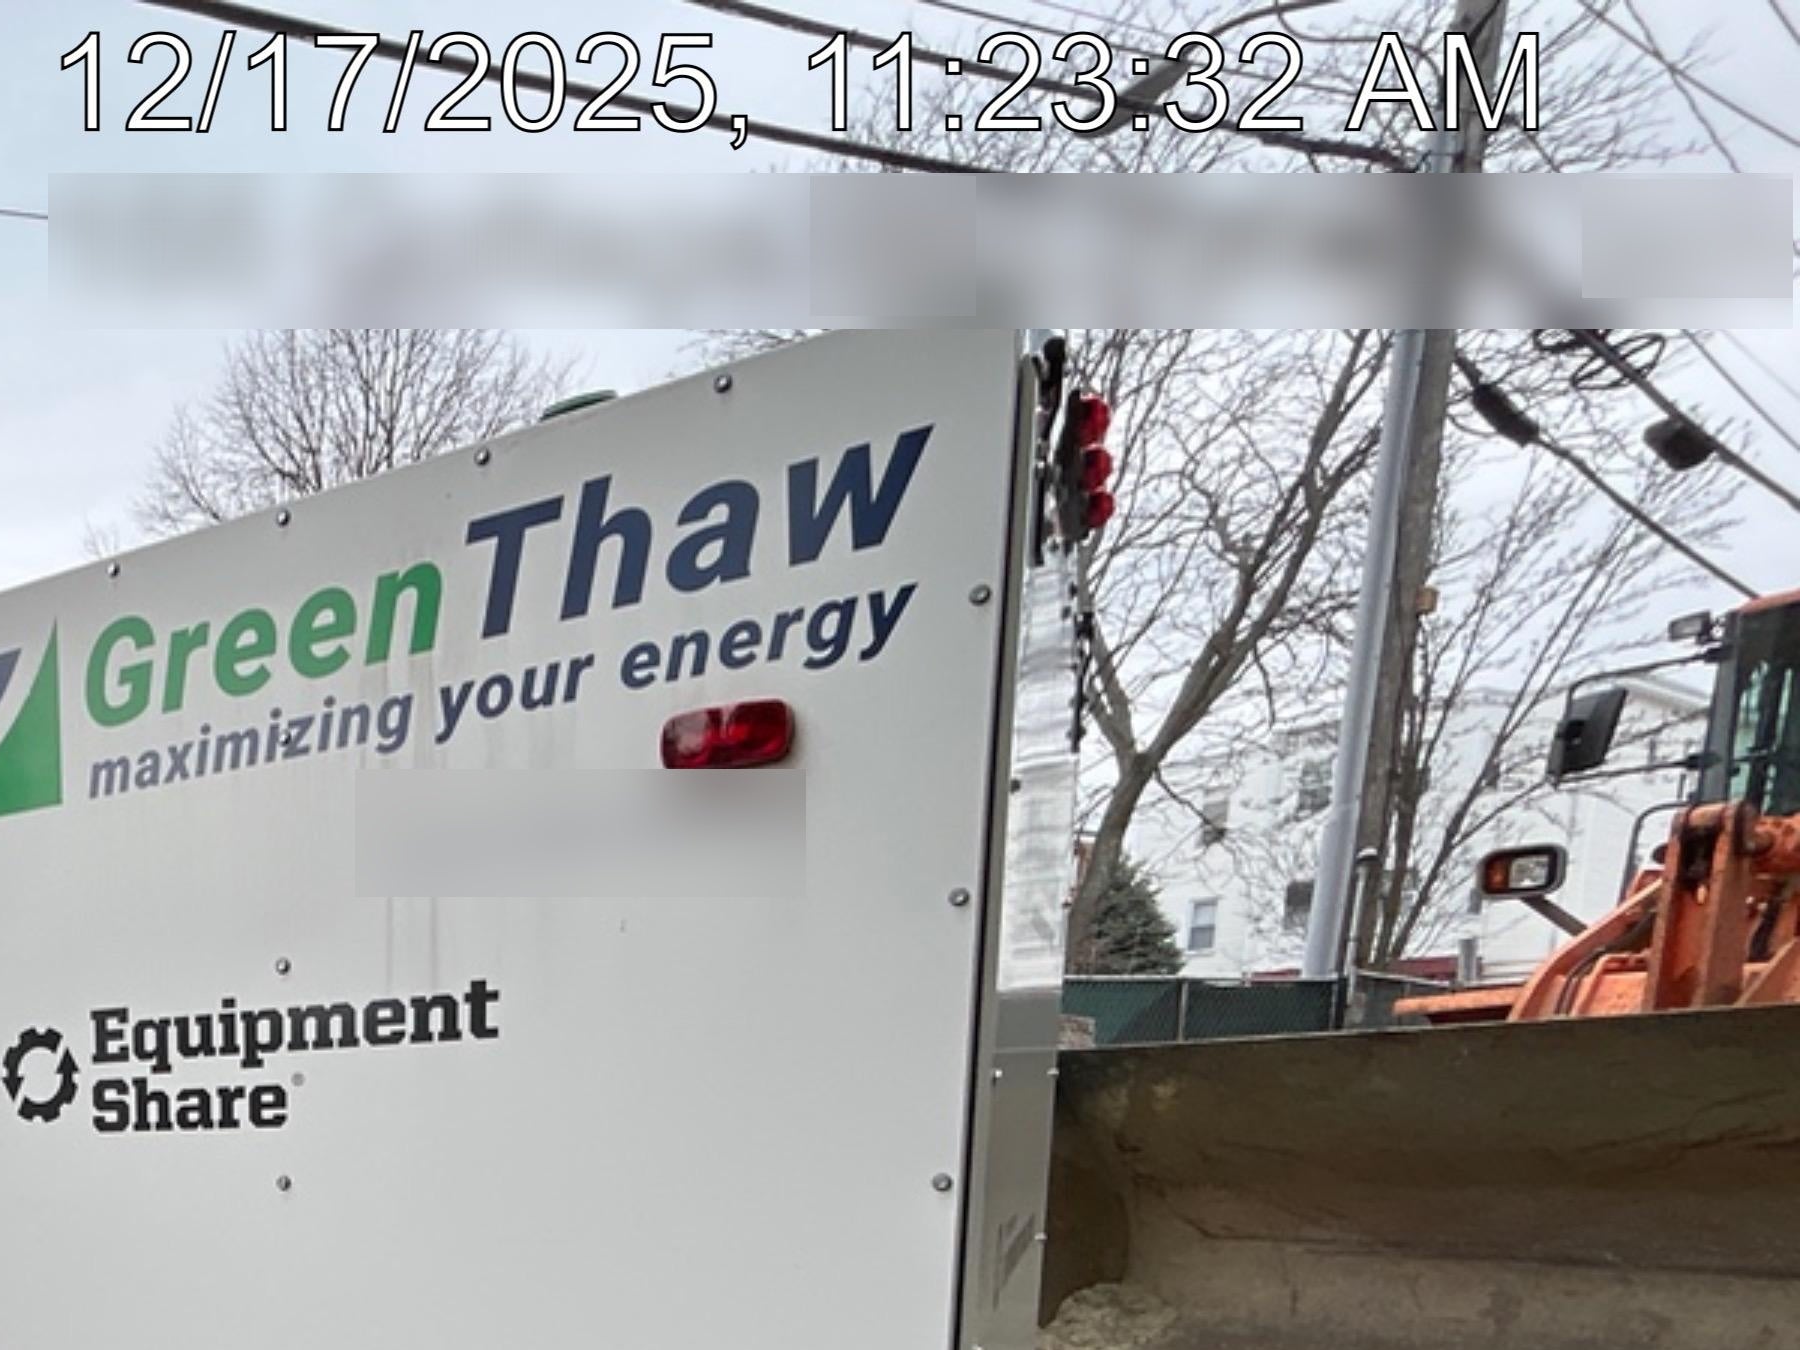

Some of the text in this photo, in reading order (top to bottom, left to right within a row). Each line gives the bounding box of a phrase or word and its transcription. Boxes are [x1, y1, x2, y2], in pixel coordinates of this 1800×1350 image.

[88, 582, 920, 799] maximizing your energy
[89, 979, 500, 1074] Equipment
[92, 1077, 288, 1132] Share
